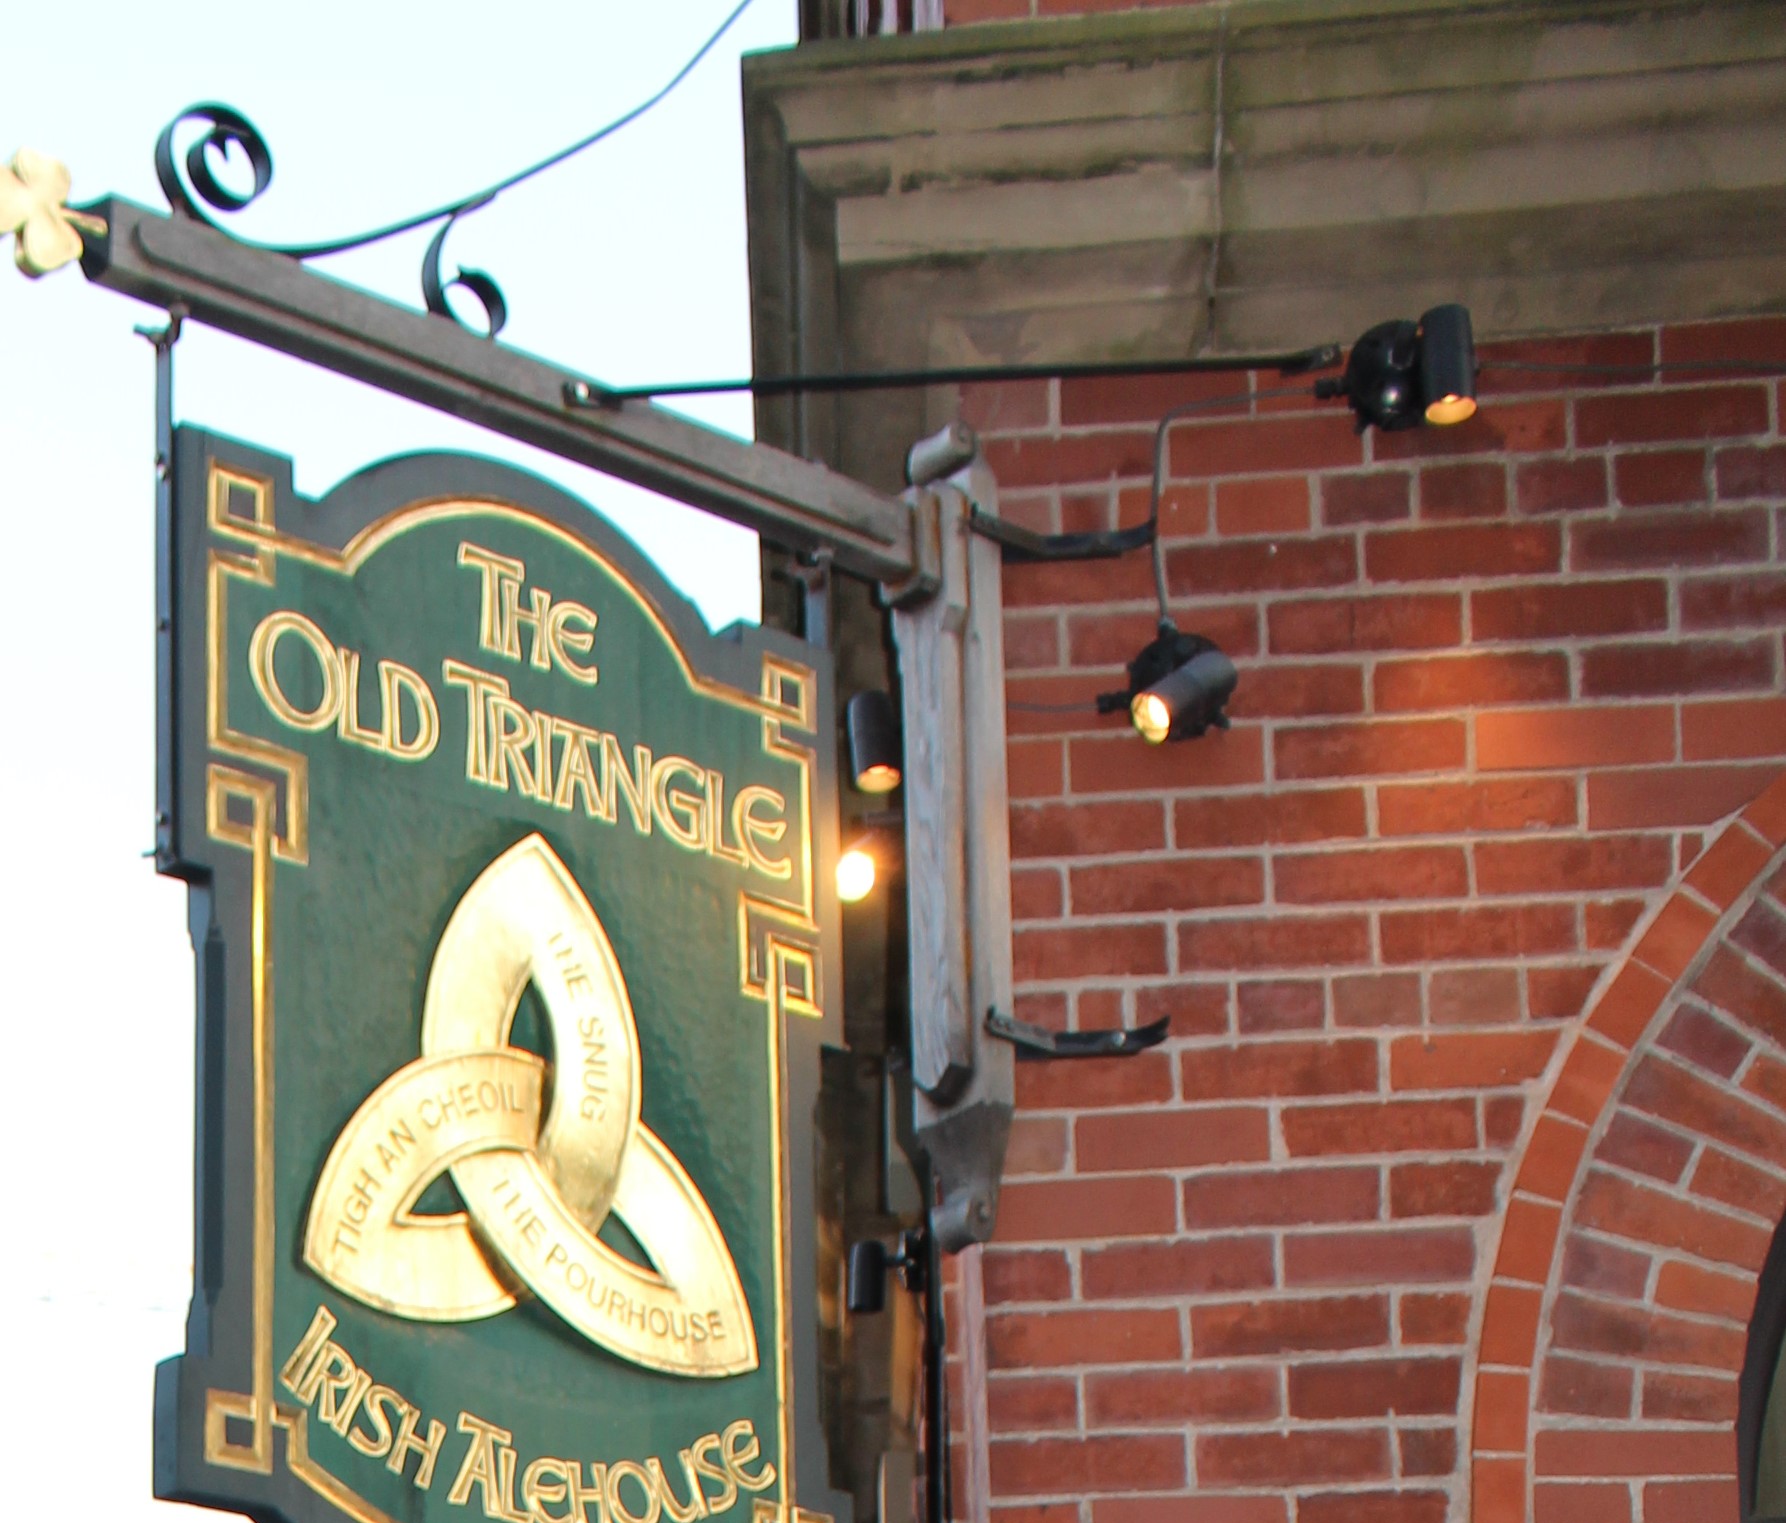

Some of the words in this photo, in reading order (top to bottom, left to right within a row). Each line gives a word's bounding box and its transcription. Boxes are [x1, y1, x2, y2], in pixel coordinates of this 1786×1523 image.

[457, 541, 598, 685] THE
[249, 610, 440, 762] OLD
[442, 658, 792, 879] TRIANGLE
[577, 1015, 609, 1122] SNUG
[331, 1167, 382, 1257] TIGH
[376, 1118, 417, 1174] AN
[418, 1080, 525, 1131] CHEOIL
[545, 1242, 726, 1343] POURHOUSE
[279, 1304, 446, 1490] IRISH
